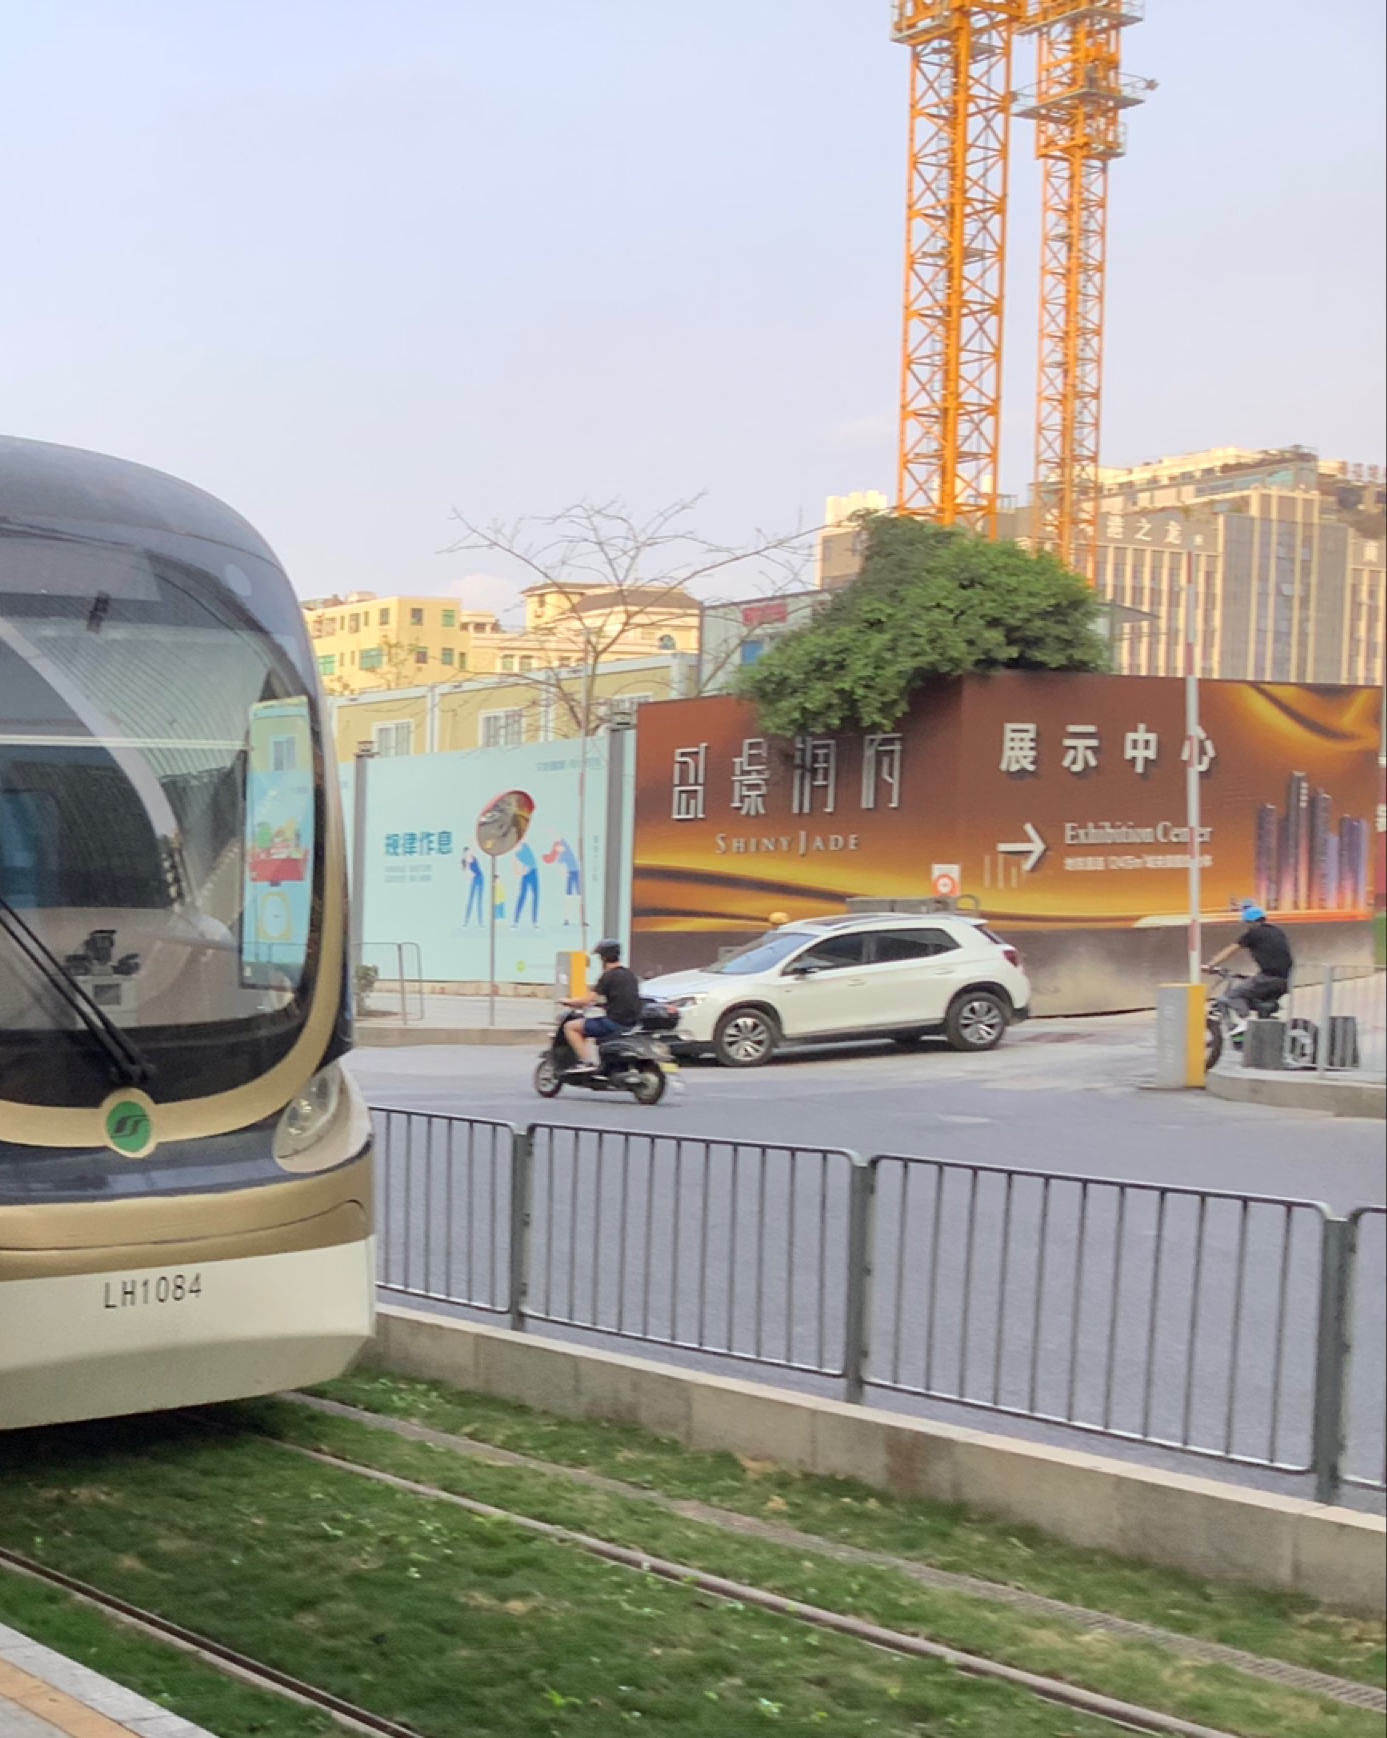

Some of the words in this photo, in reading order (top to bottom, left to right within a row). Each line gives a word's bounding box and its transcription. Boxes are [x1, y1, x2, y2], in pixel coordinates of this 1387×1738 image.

[999, 722, 1217, 775] 展示中心
[385, 830, 453, 856] 规律作息
[797, 829, 860, 856] JADE
[1064, 822, 1154, 845] Exhibition
[1156, 820, 1213, 843] Cener
[103, 1272, 203, 1309] LH1084
